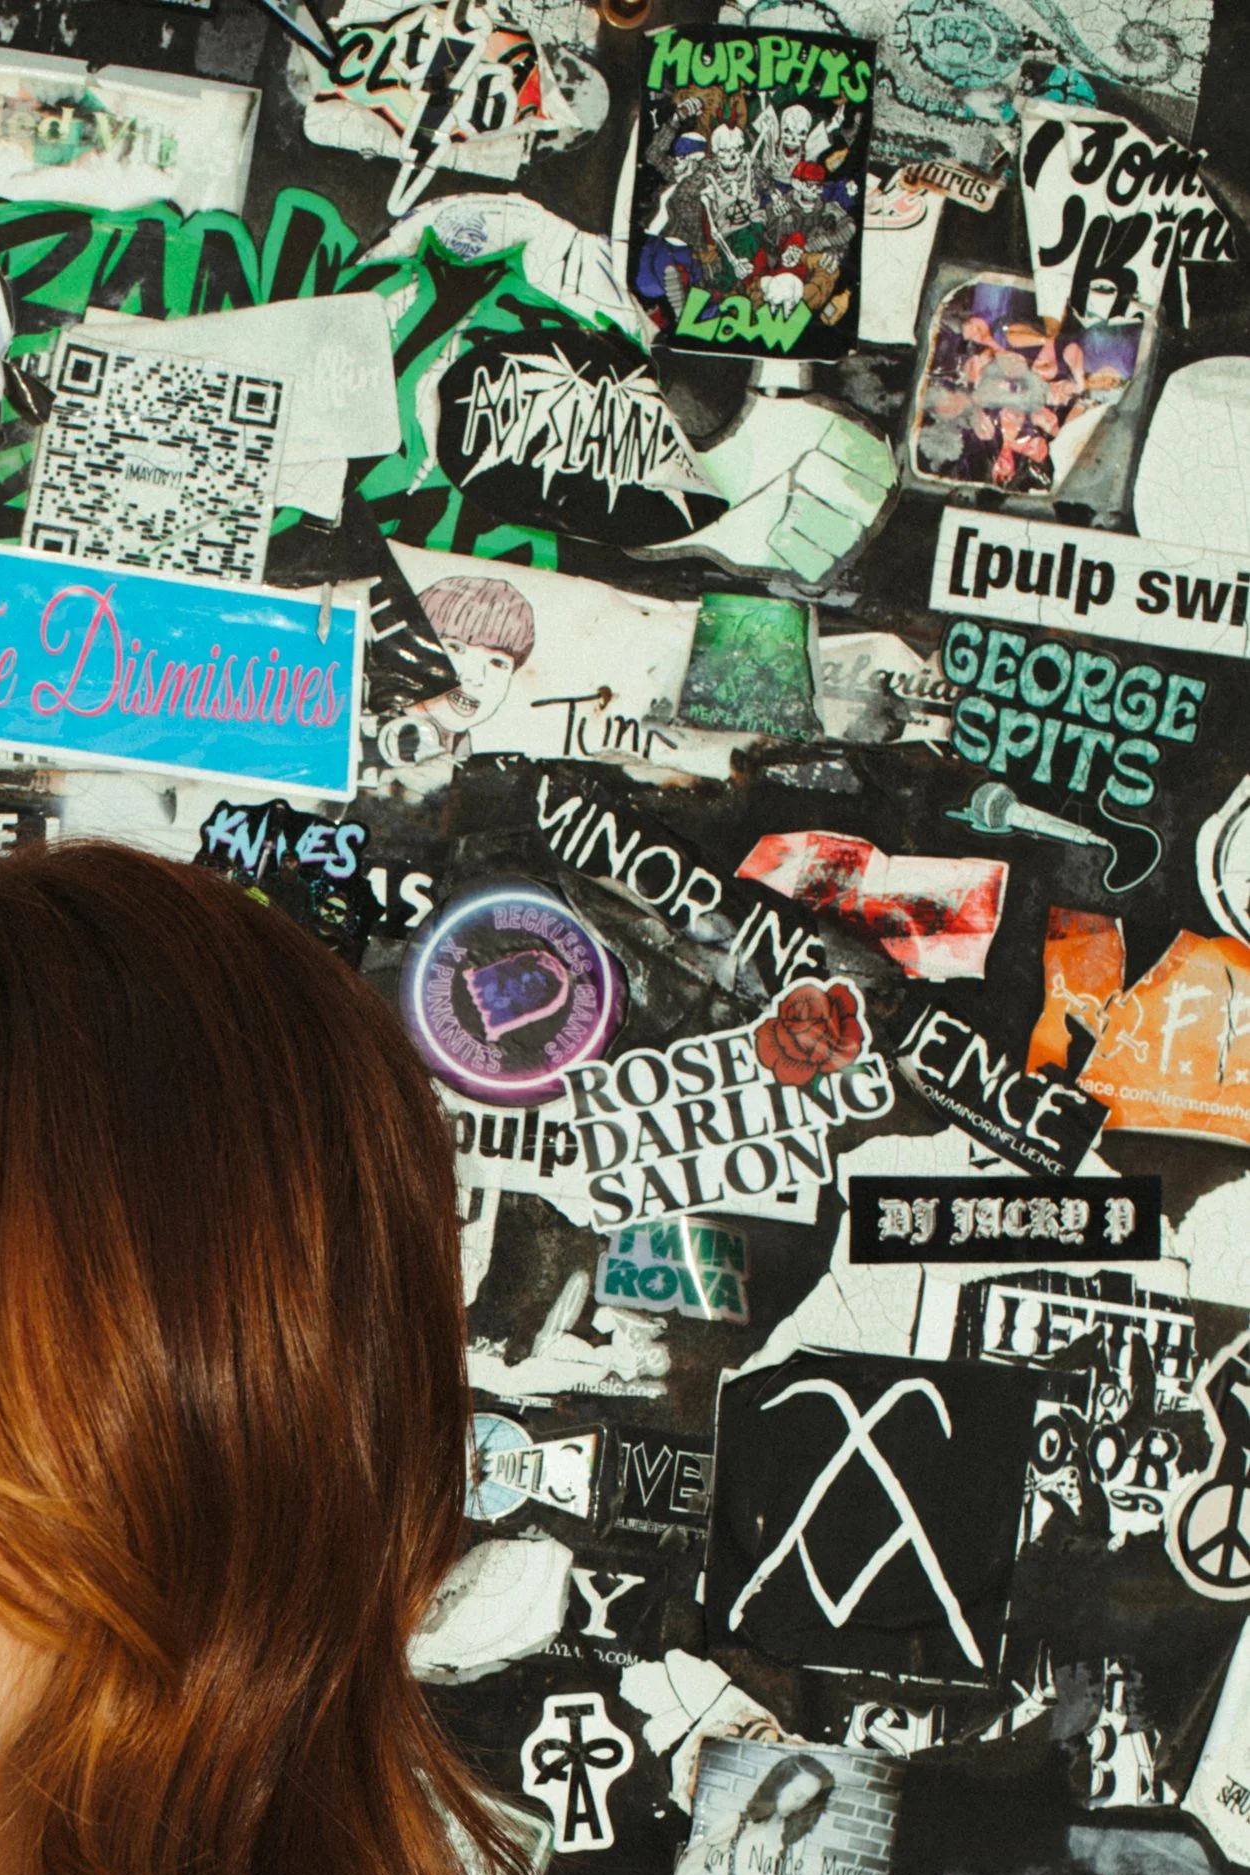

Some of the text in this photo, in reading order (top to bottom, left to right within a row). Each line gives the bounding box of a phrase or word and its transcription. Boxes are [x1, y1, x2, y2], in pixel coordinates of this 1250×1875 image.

[30, 584, 344, 728] Dismissives
[941, 621, 1208, 744] GEORGE
[952, 697, 1162, 806] SPITS
[492, 904, 593, 977] RECKLESS
[544, 983, 598, 1064] GIANTS
[567, 1031, 762, 1120] ROSE
[575, 1058, 890, 1174] DARLING
[588, 1131, 828, 1229] SALON
